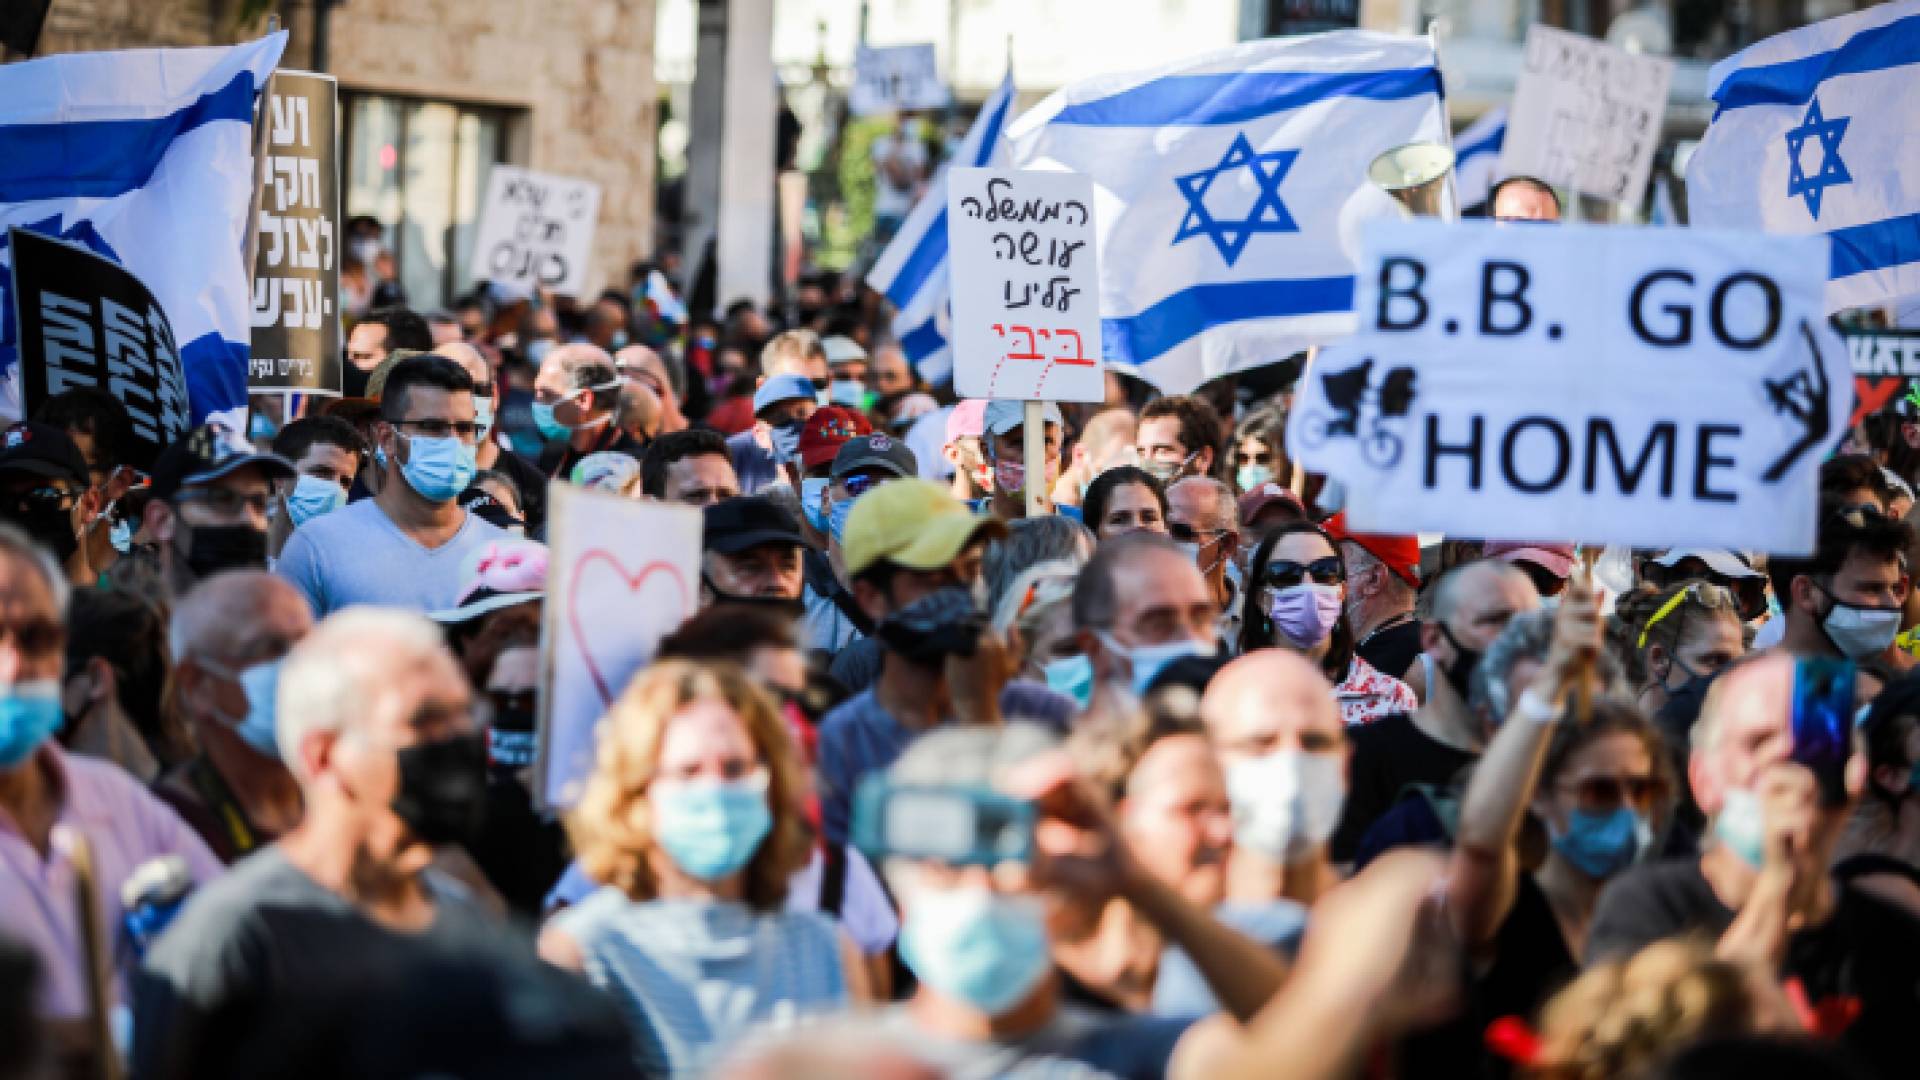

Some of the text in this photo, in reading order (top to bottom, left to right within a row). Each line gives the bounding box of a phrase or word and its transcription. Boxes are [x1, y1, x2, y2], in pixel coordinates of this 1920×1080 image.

[271, 94, 311, 147] וע
[264, 156, 320, 211] חקי
[960, 177, 1088, 226] הממשלה
[258, 210, 333, 271] לצול
[992, 230, 1087, 269] עושה
[1004, 275, 1081, 312] עלינו
[1375, 255, 1783, 351] B.B. GO
[990, 322, 1097, 368] ביבי
[1422, 411, 1743, 504] HOME
